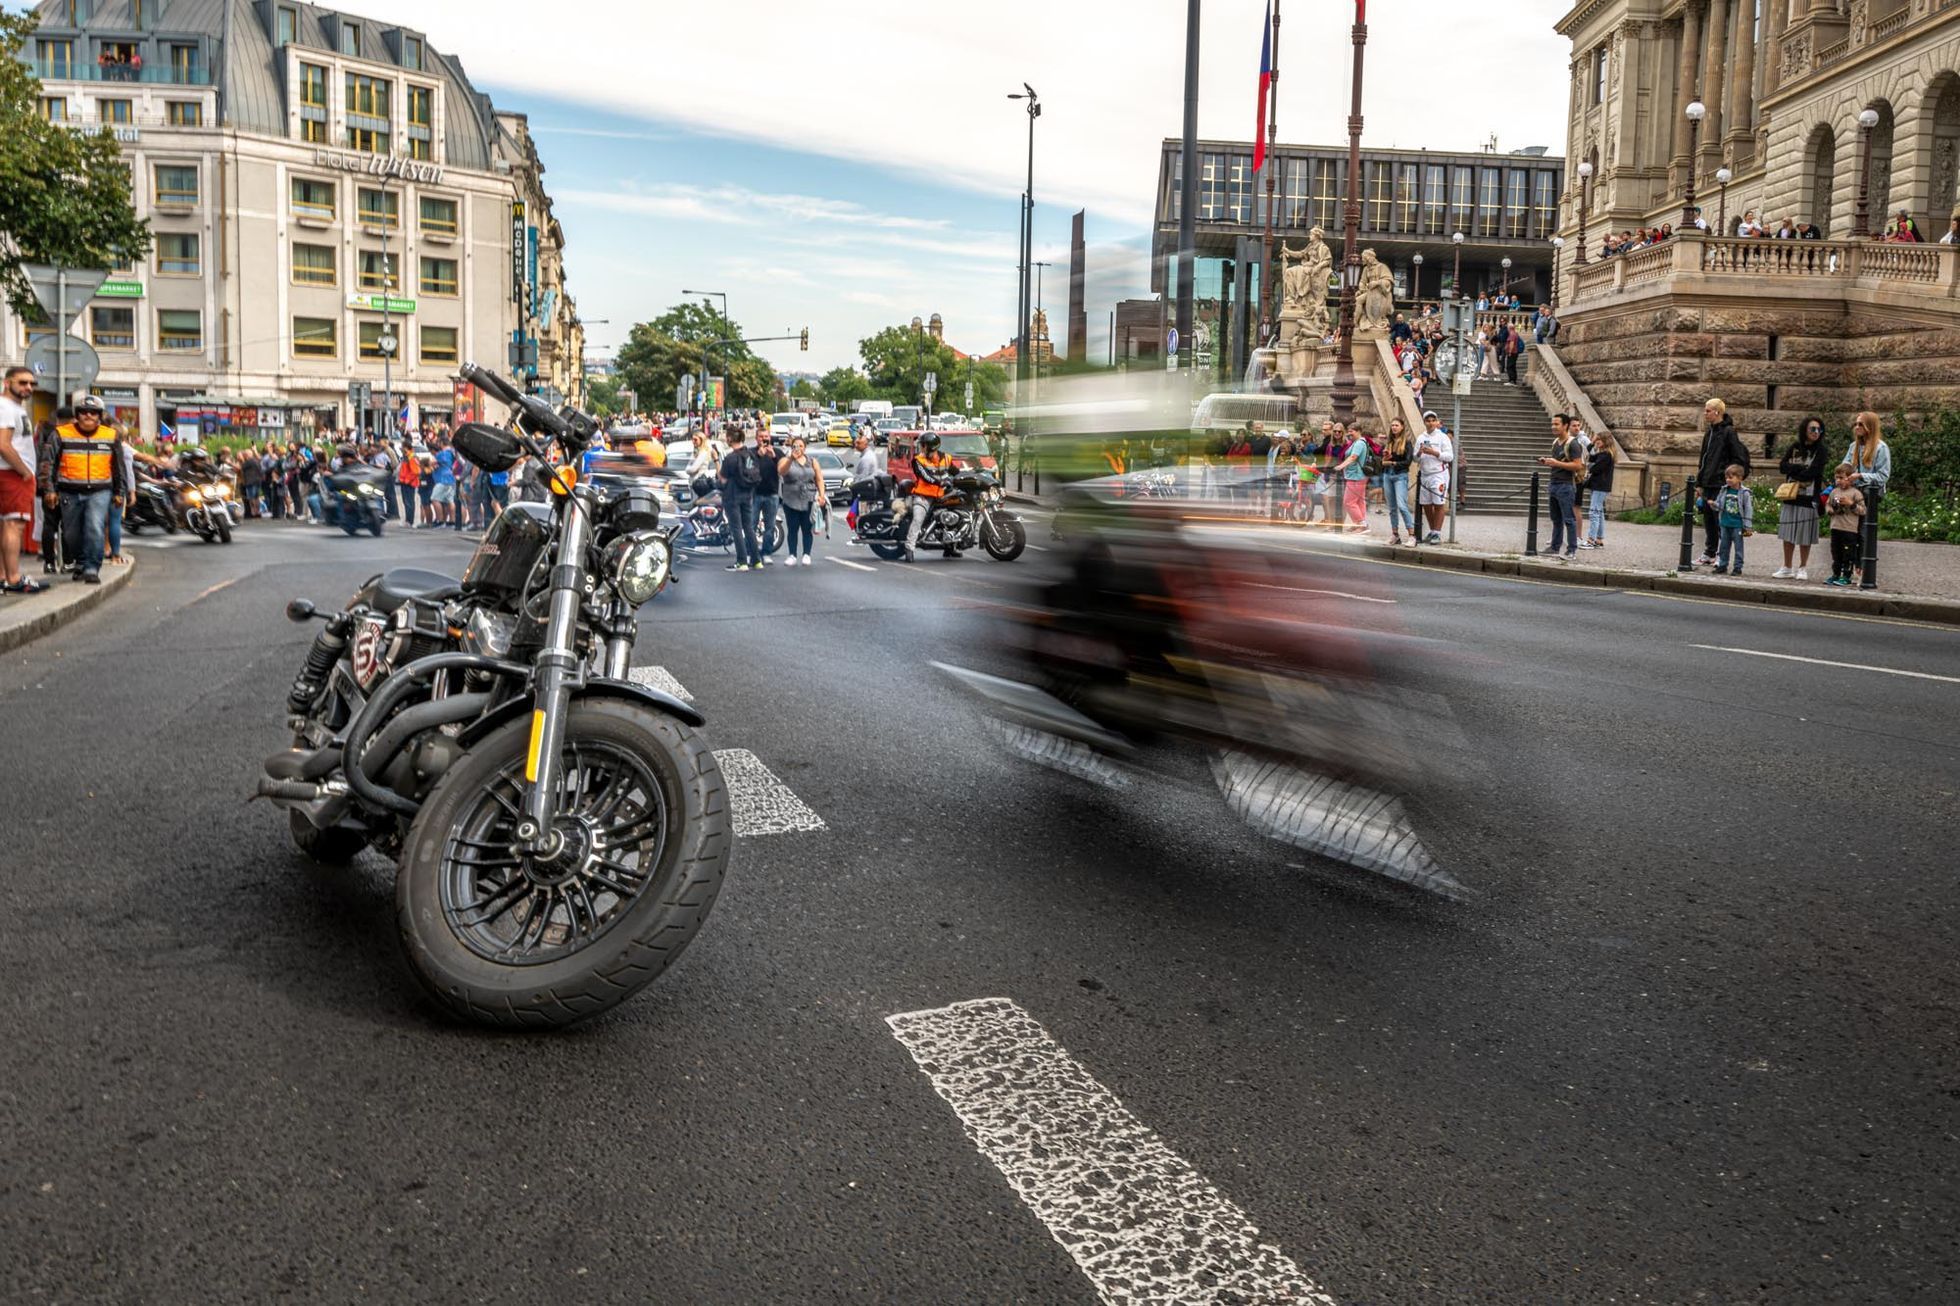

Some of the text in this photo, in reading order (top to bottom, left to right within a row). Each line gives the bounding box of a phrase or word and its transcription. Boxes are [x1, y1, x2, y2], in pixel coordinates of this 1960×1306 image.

[316, 147, 443, 184] Hotel Wilson
[373, 299, 414, 309] SUPRMARKET
